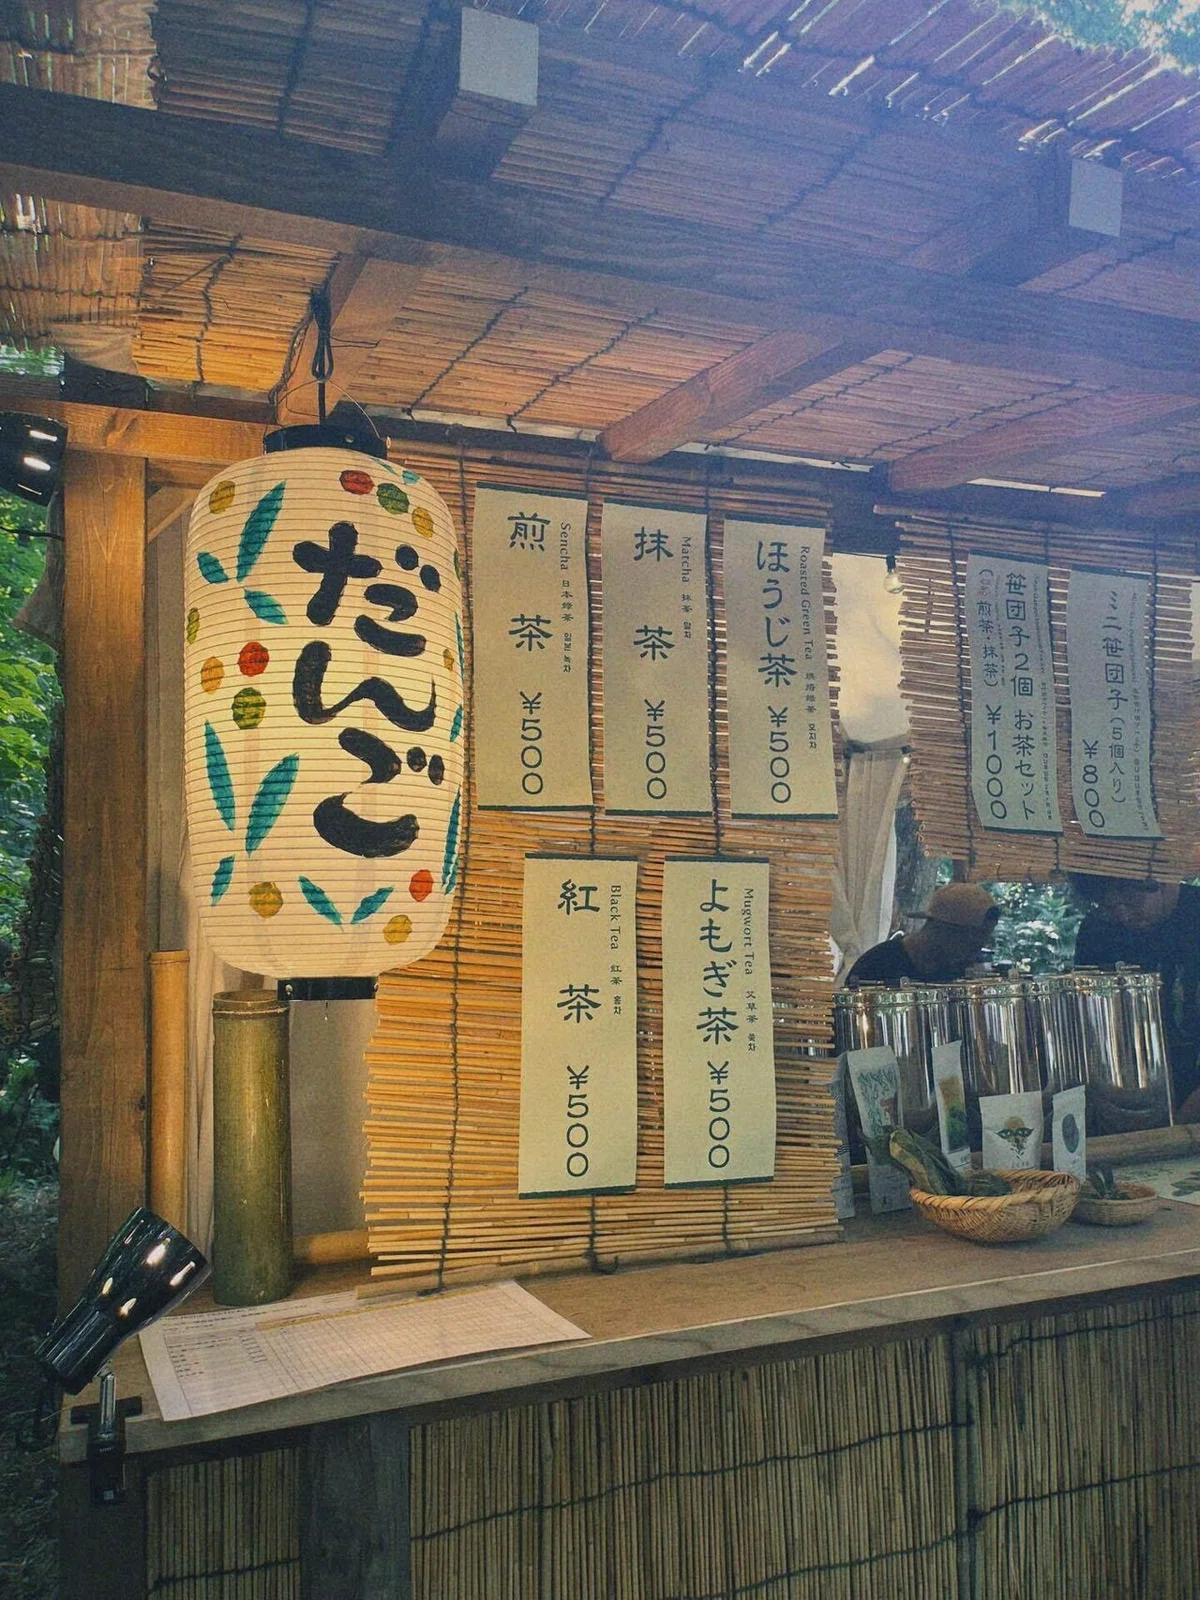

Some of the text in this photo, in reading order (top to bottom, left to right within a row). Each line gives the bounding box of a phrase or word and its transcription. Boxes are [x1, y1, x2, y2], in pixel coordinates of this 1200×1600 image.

[560, 522, 572, 571] Sencha
[681, 536, 692, 583] Matcha
[800, 546, 811, 595] Roasted
[507, 511, 553, 795] 煎茶 ¥500
[802, 599, 811, 635] Green
[805, 639, 814, 660] Tea
[292, 520, 445, 859] だんご
[633, 526, 675, 800] 抹茶 ¥500
[756, 540, 797, 803] ほうじ茶 ¥500
[1005, 573, 1036, 821] 笹団子2個 お茶セット
[1102, 590, 1128, 804] ミニ笹団子（5個入り）
[985, 704, 1008, 820] ¥1000
[1082, 739, 1105, 828] ¥800
[610, 885, 621, 921] Black
[610, 925, 621, 950] Tea
[741, 888, 754, 948] Mugwort
[610, 964, 622, 985] 紅茶
[745, 952, 754, 975] Tea
[557, 879, 602, 1177] 紅茶 ¥500
[696, 879, 739, 1168] よもぎ茶 ¥500
